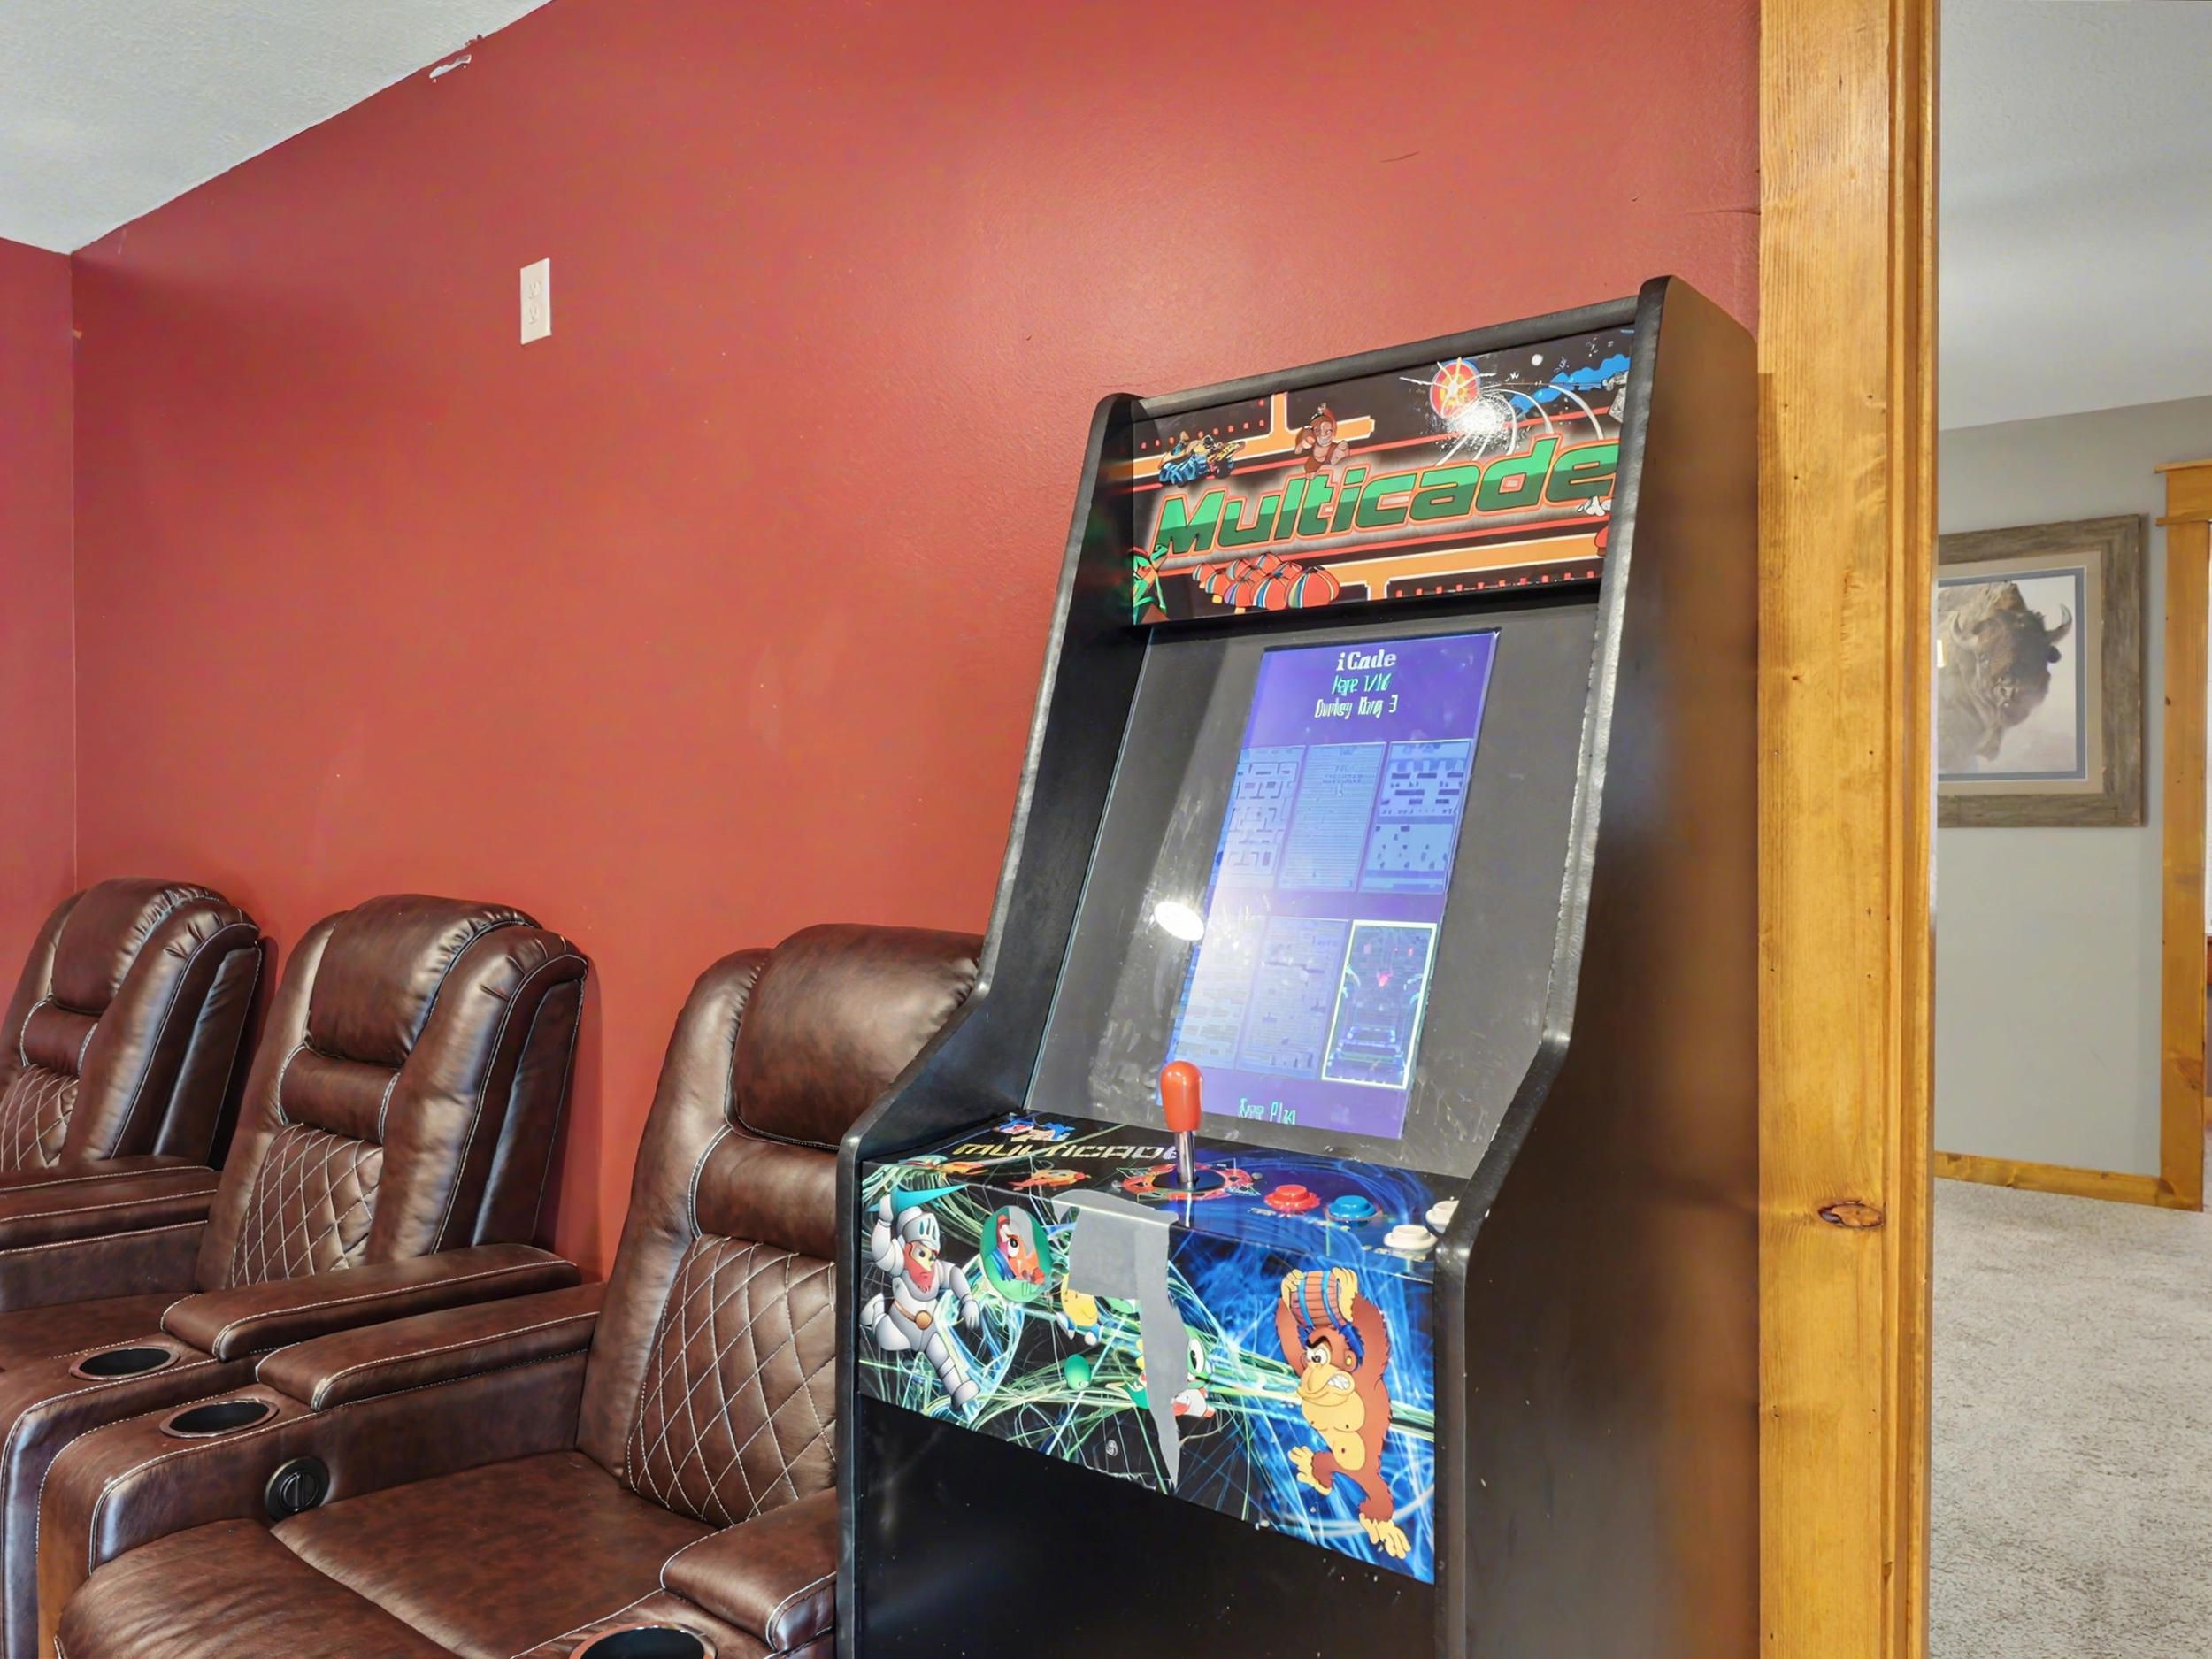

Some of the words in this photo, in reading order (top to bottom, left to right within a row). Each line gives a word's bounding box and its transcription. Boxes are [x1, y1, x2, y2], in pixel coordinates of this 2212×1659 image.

[1154, 435, 1618, 556] Multicade
[1336, 649, 1396, 672] iCade
[1388, 694, 1398, 713] 3
